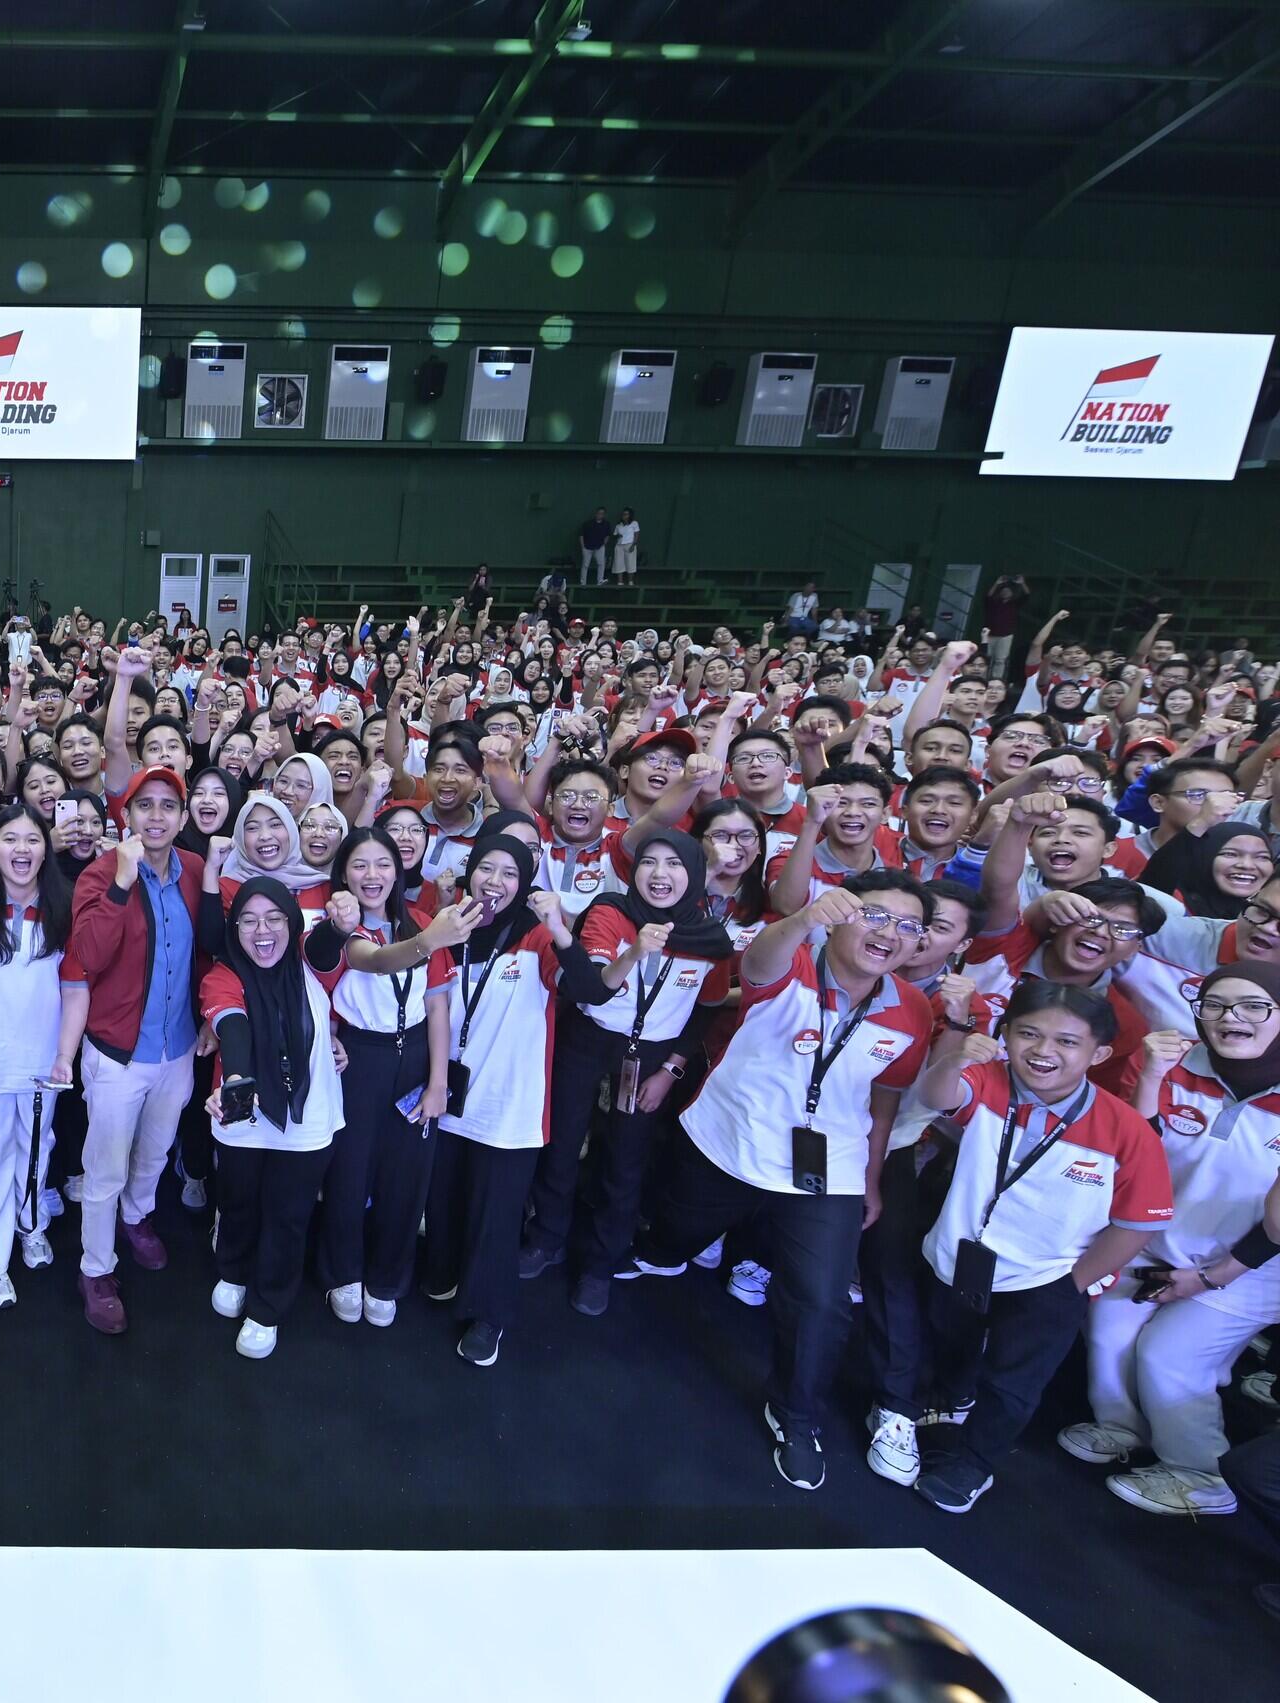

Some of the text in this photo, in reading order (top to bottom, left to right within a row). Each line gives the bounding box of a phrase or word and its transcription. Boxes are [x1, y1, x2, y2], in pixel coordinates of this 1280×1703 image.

[1080, 402, 1170, 422] NATION
[1, 427, 31, 435] Djarum
[1070, 424, 1173, 444] BUILDING
